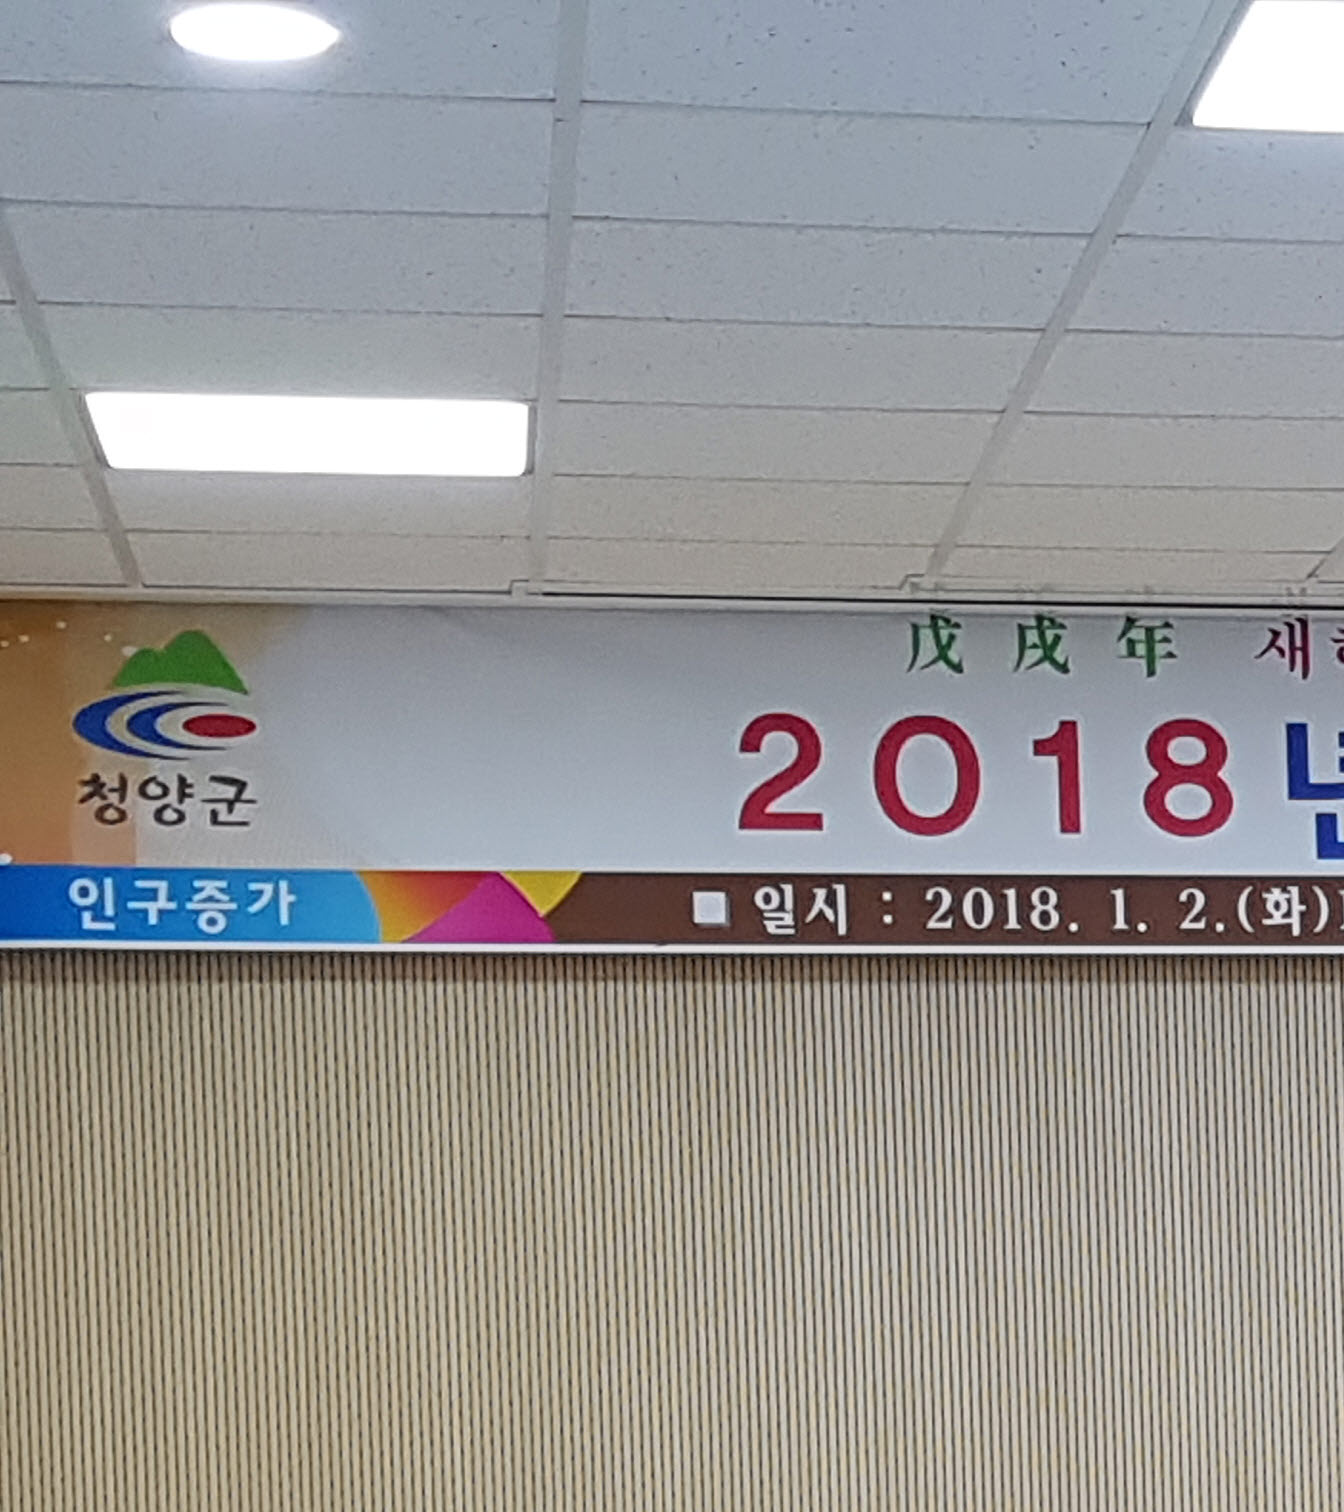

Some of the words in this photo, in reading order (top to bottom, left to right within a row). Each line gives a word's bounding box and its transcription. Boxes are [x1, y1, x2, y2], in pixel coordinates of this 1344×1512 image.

[77, 772, 258, 827] 청양군
[67, 876, 297, 933] 인구증가
[753, 883, 850, 936] 일시
[925, 886, 1080, 933] 2018.
